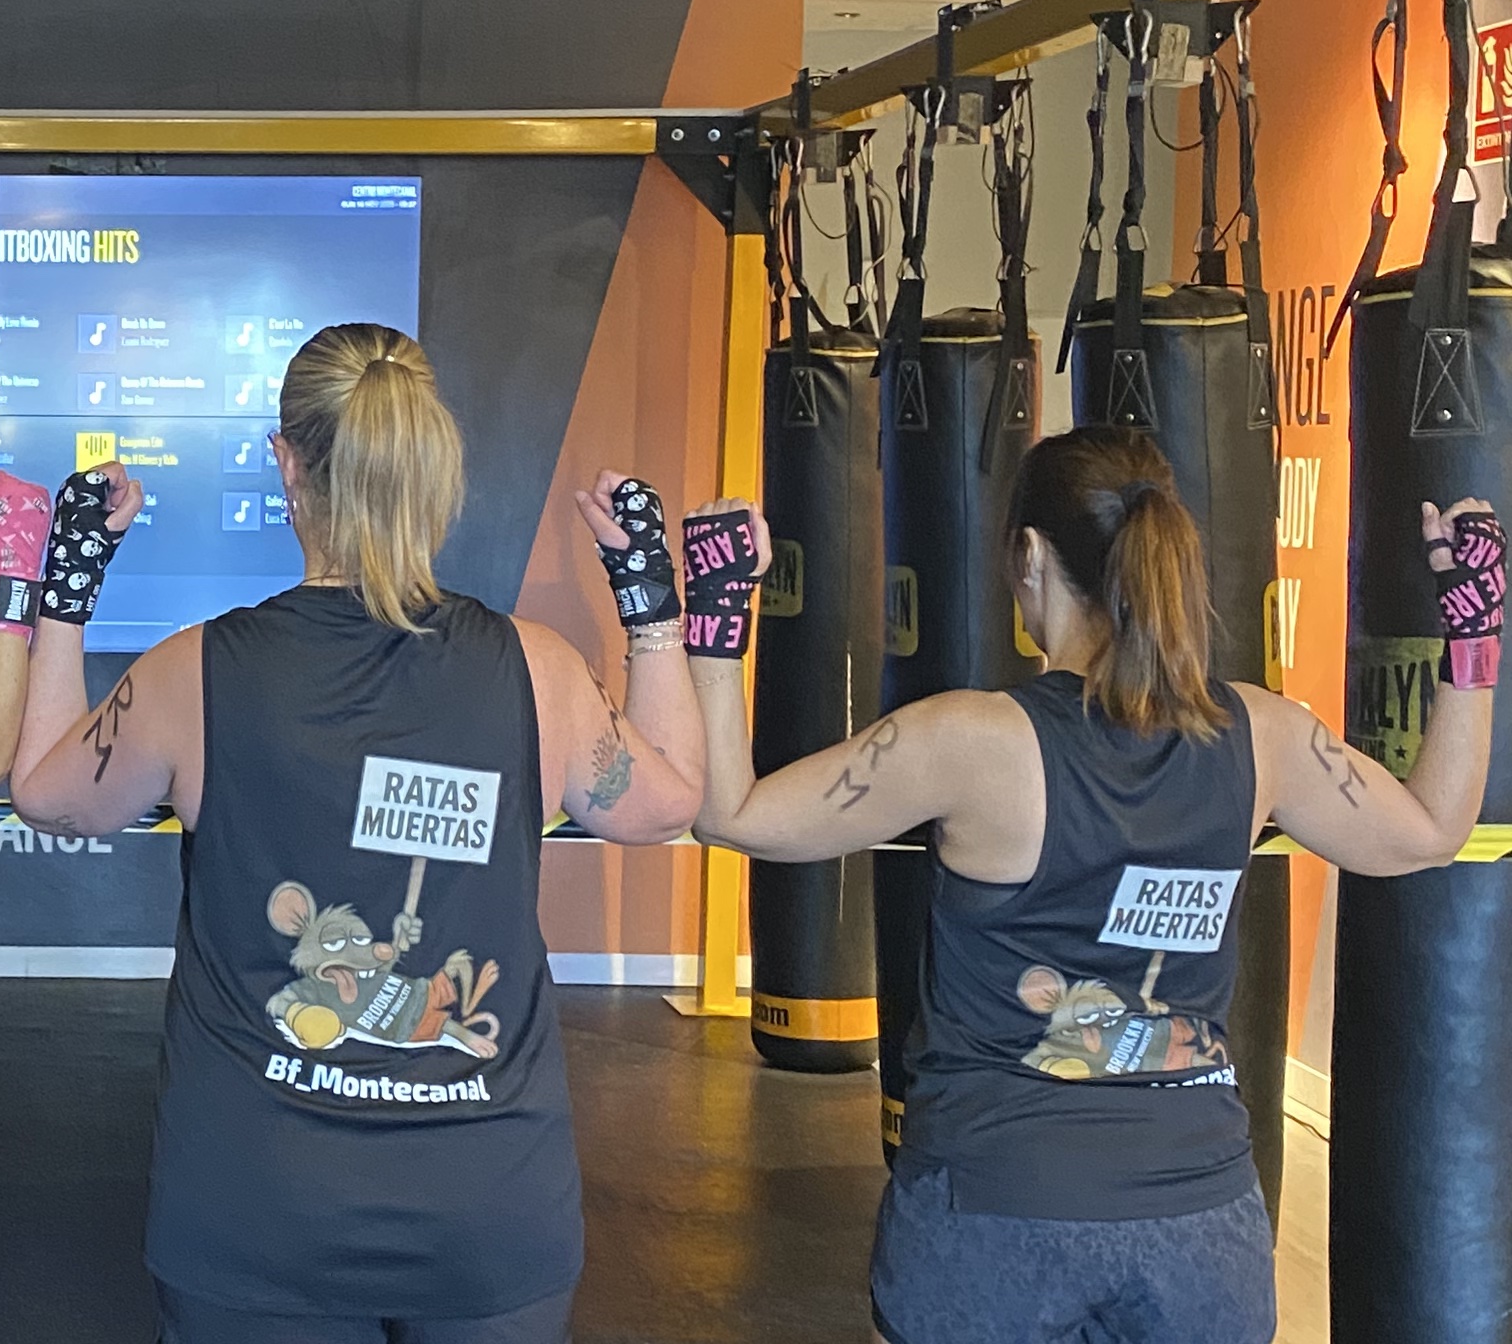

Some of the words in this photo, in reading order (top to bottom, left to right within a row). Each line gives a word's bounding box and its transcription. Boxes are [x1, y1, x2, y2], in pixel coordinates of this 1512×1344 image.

[94, 230, 139, 263] HITS
[1275, 285, 1335, 427] NGE
[1278, 457, 1321, 549] ODY
[383, 771, 480, 813] RATAS
[360, 805, 488, 849] MUERTAS
[1136, 878, 1223, 909] RATAS
[1109, 907, 1223, 941] MUERTAS
[264, 1053, 491, 1103] Bf_Montecanal
